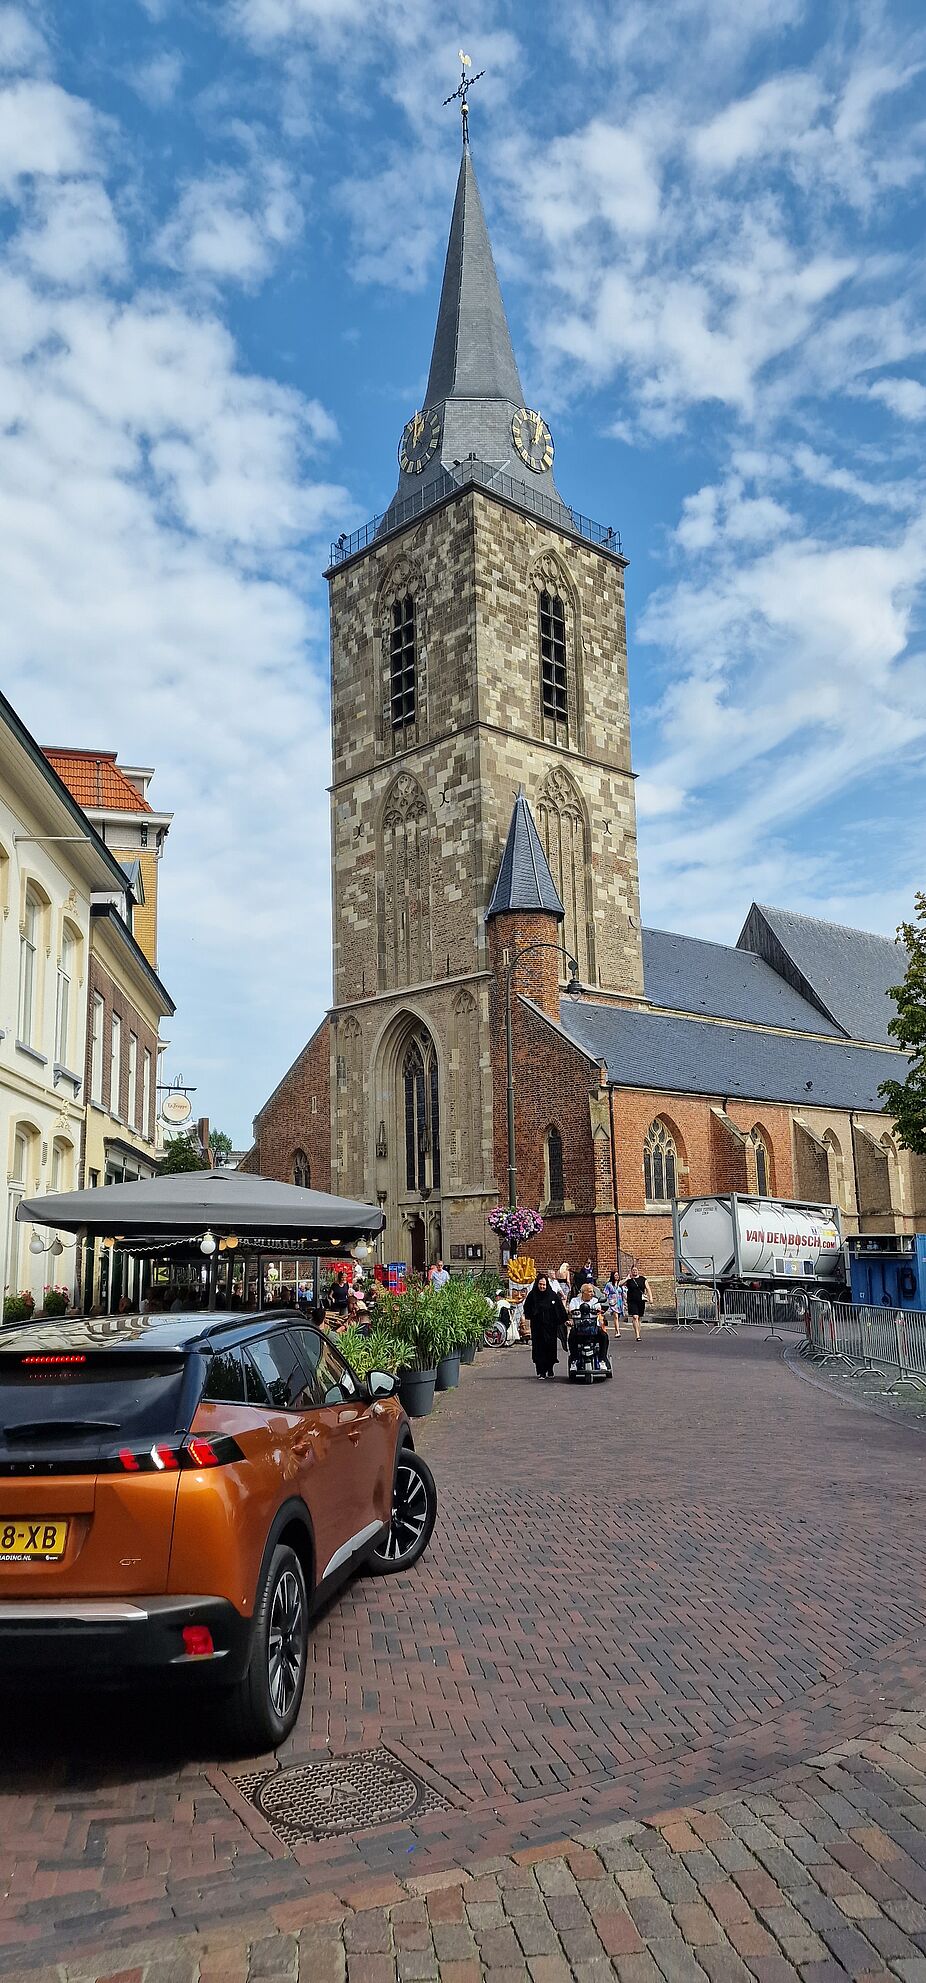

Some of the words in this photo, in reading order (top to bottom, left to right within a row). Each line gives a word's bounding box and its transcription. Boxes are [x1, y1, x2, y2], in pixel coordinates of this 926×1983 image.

[746, 1229, 763, 1243] VAN
[766, 1231, 786, 1245] DEN
[1, 1525, 57, 1549] 8-XB
